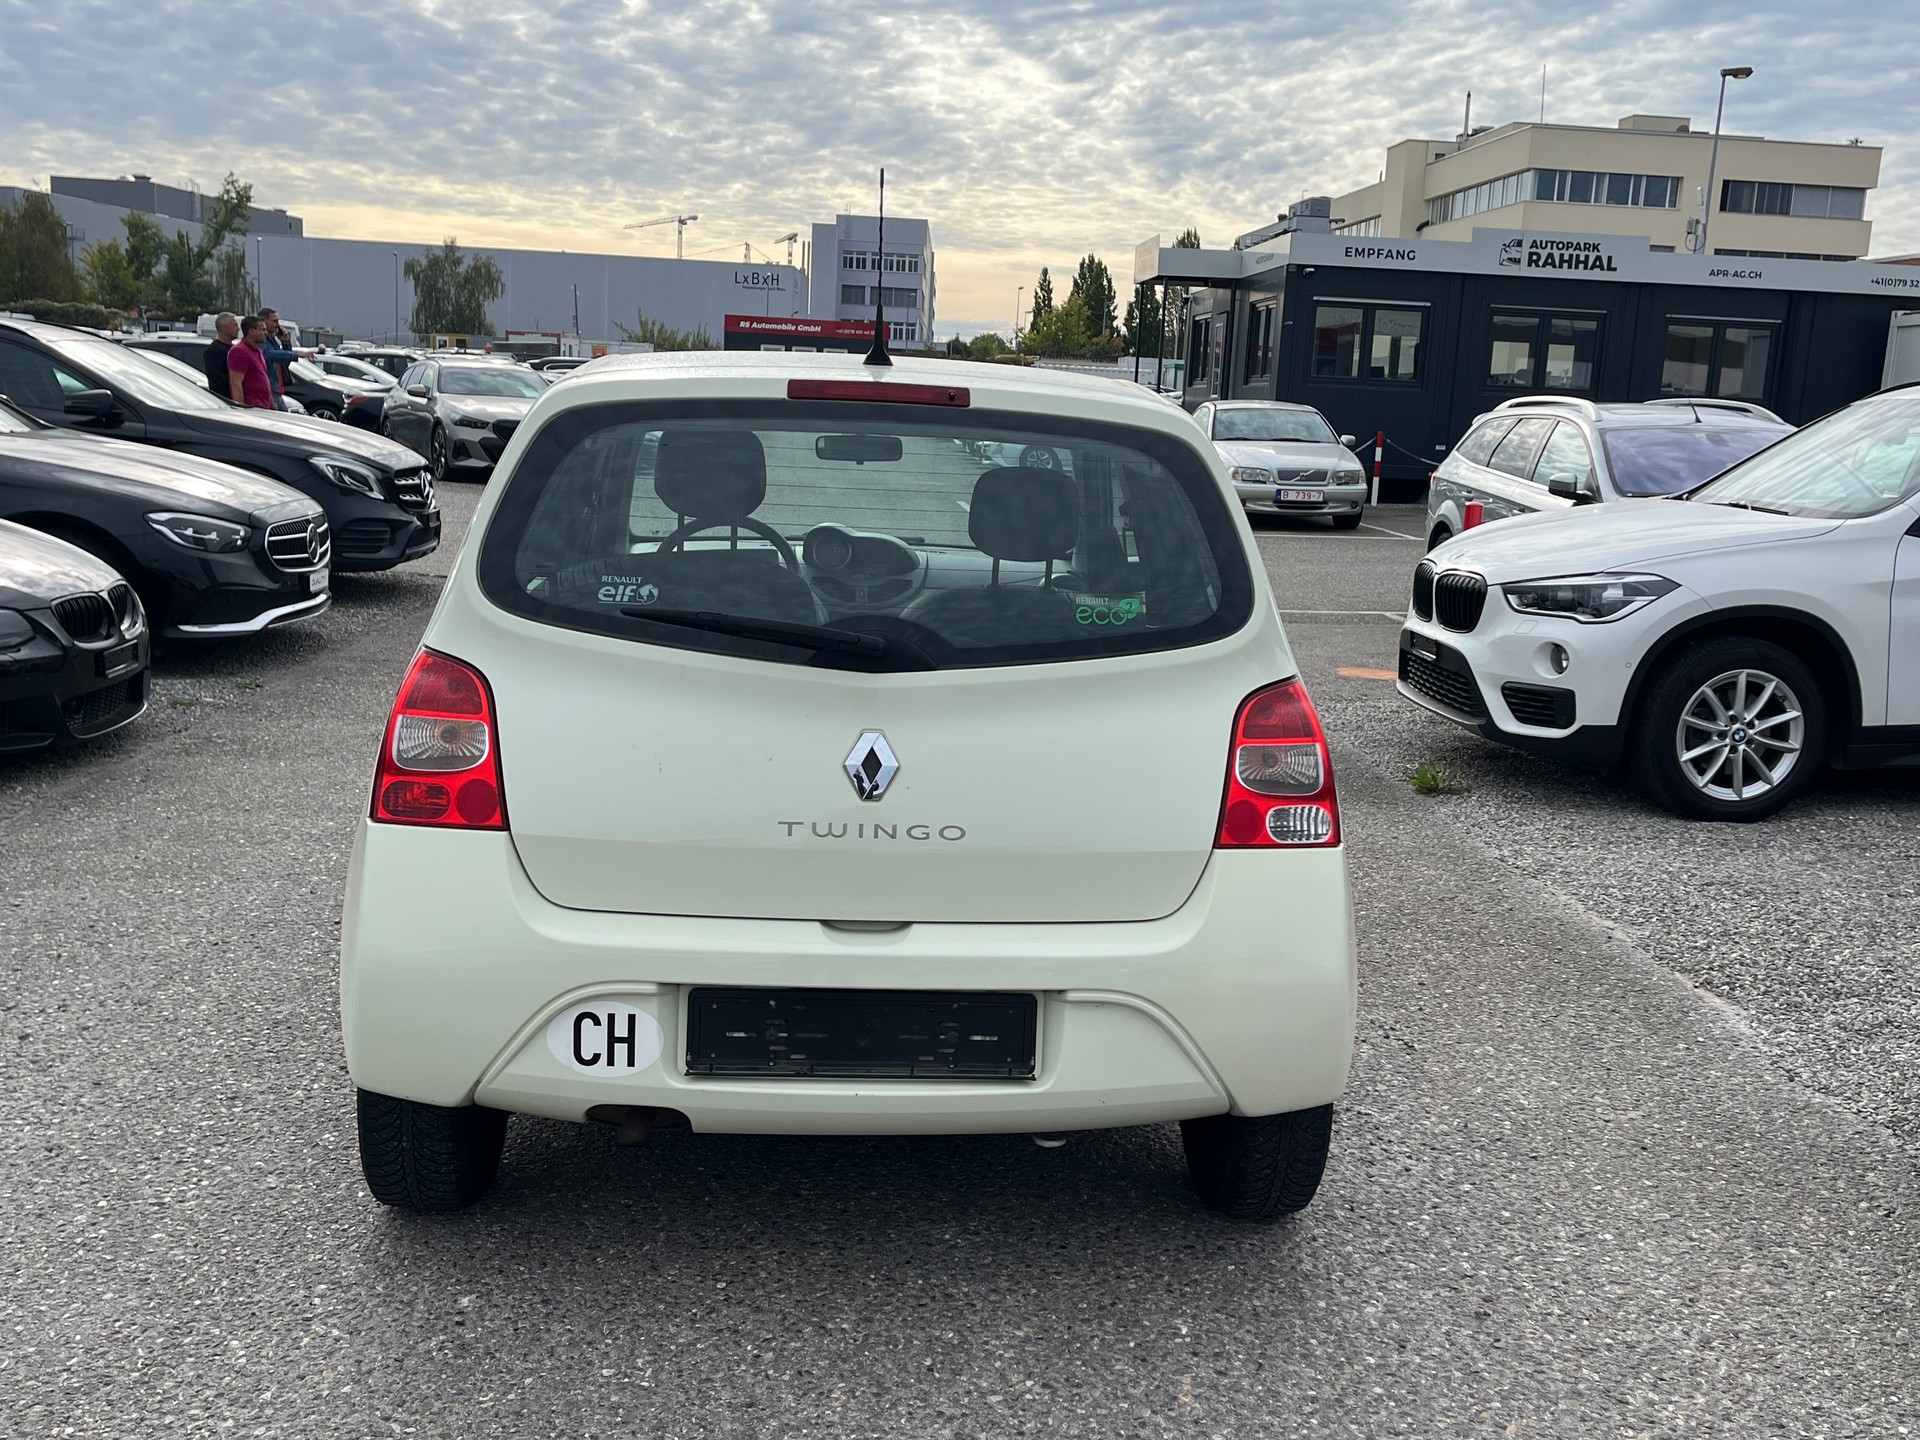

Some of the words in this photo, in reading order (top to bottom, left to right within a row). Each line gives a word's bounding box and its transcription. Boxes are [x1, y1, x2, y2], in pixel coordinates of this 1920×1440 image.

[1529, 239, 1601, 253] AUTOPARK
[1344, 246, 1417, 261] EMPFANG
[1527, 251, 1618, 272] RAHHAL
[734, 271, 780, 286] LxBxH
[1708, 268, 1762, 280] APR-AG.CH
[1908, 279, 1920, 288] 32
[751, 321, 796, 331] Automobile
[797, 324, 822, 333] GmbH
[601, 575, 643, 584] RENAULT
[598, 585, 637, 602] elf
[1075, 596, 1109, 605] RENAULT
[778, 821, 967, 841] TWINGO
[572, 1011, 637, 1068] CH
